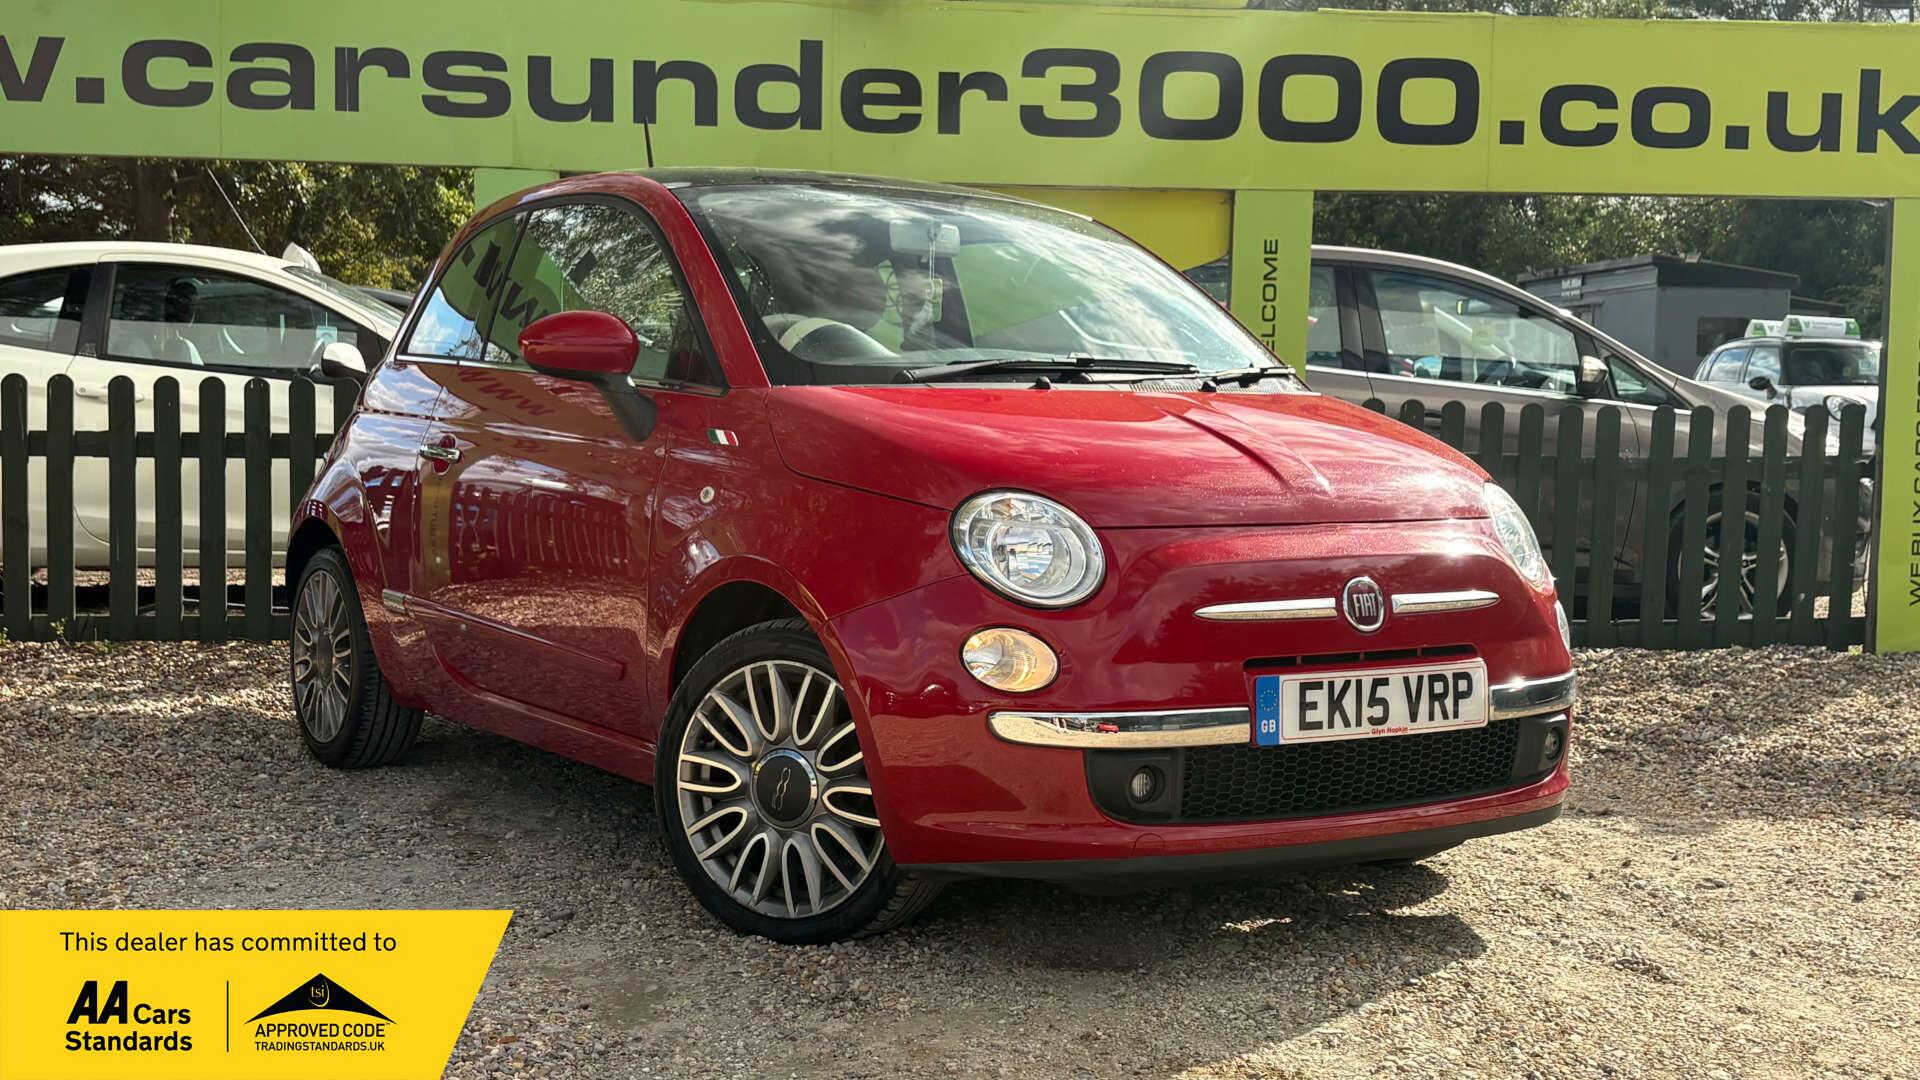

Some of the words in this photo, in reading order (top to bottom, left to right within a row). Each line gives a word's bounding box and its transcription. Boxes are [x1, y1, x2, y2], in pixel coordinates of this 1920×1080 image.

[1352, 593, 1377, 618] FIAT
[1299, 677, 1390, 731] EK15
[1402, 671, 1473, 724] VRP
[1261, 718, 1277, 734] GB
